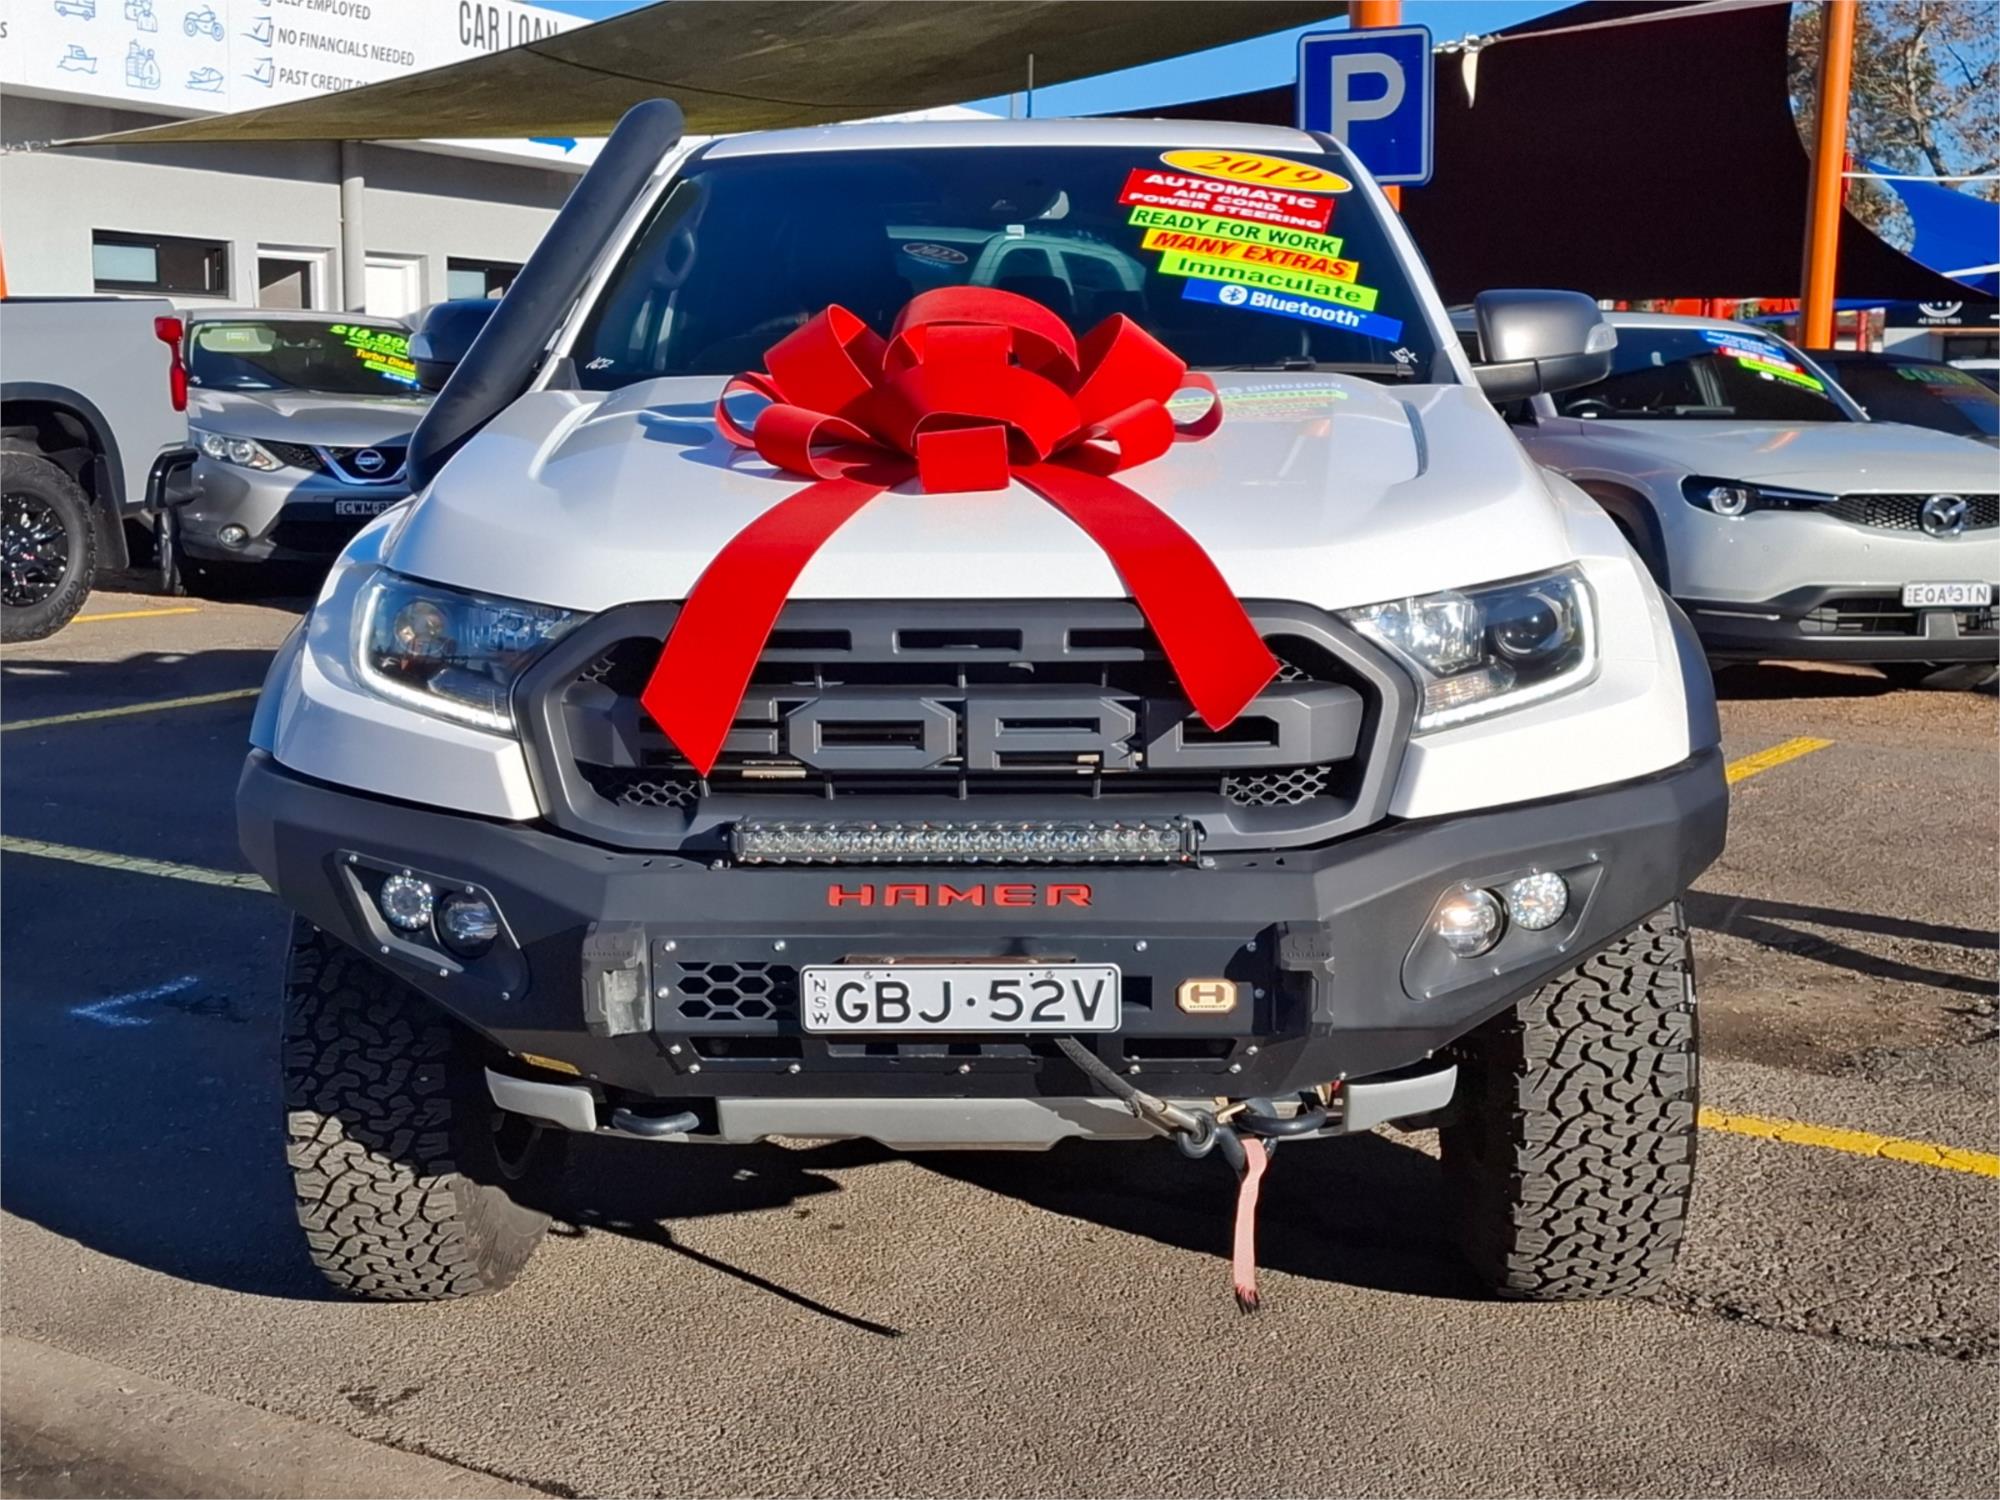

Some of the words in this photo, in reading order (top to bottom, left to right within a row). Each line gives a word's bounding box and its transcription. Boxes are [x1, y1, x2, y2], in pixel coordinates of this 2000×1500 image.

[459, 0, 500, 51] CAR
[278, 27, 297, 45] NO
[299, 31, 369, 58] FINANCIALS
[370, 45, 415, 66] NEEDED
[279, 67, 309, 86] PAST
[1331, 52, 1406, 149] P
[1192, 155, 1324, 183] 2019
[1143, 174, 1317, 209] AUTOMATIC
[1174, 189, 1213, 202] AIR
[1216, 195, 1284, 213] COND.
[1128, 192, 1206, 210] POWER
[1211, 204, 1323, 229] STEERING
[1134, 210, 1210, 232] READY
[1215, 219, 1260, 240] FOR
[1267, 230, 1336, 254] WORK
[1151, 231, 1237, 256] MANY
[1241, 241, 1350, 277] EXTRAS
[1177, 257, 1362, 303] Immaculate
[1249, 290, 1360, 328] Bluetooth
[356, 347, 386, 363] Turbo
[387, 356, 416, 372] Diese
[826, 883, 1093, 907] HAMER
